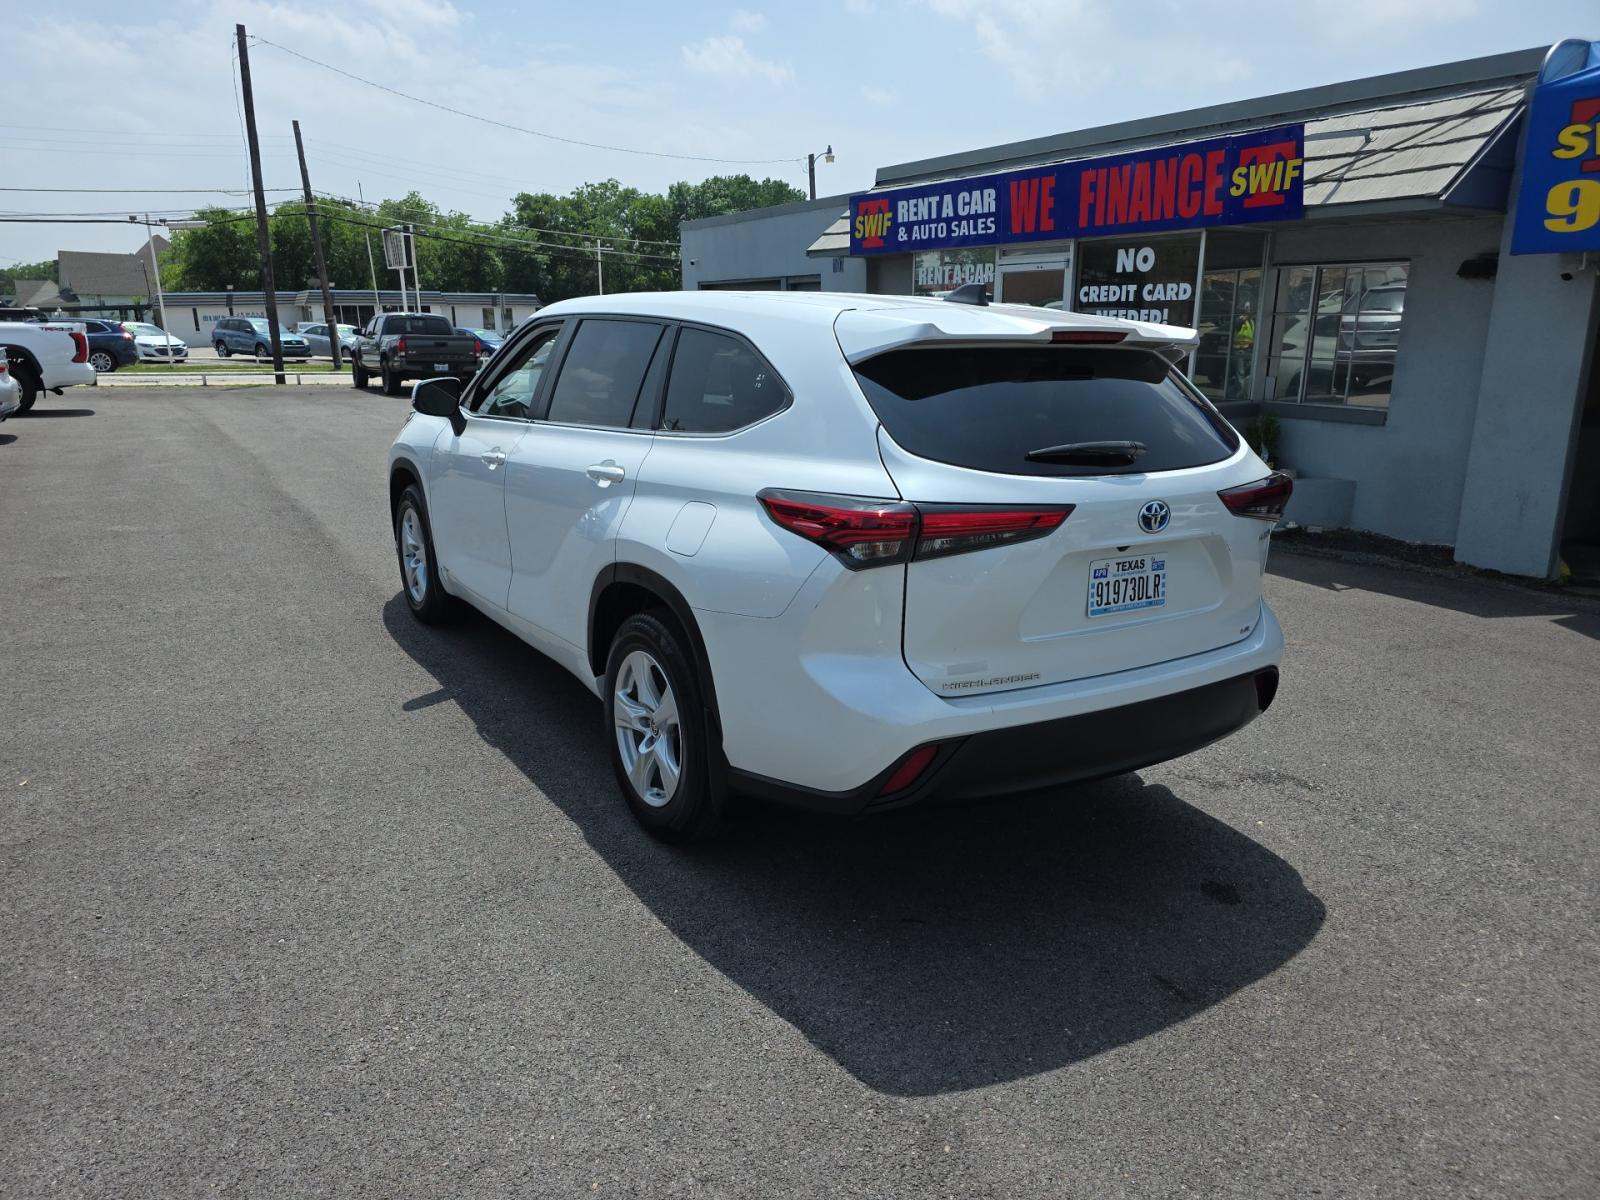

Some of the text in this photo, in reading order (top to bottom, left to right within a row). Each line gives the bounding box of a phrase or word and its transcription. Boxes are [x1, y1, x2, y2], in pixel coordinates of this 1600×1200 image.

[1010, 149, 1226, 234] WE FINANCE
[897, 188, 996, 223] RENT A CAR
[897, 217, 996, 242] & AUTO SALES
[1116, 246, 1156, 273] NO
[918, 263, 994, 285] RENT A CAR
[1080, 282, 1192, 303] CREDIT CARD
[1115, 559, 1146, 572] TEXAS
[1096, 573, 1161, 608] 91973DLR
